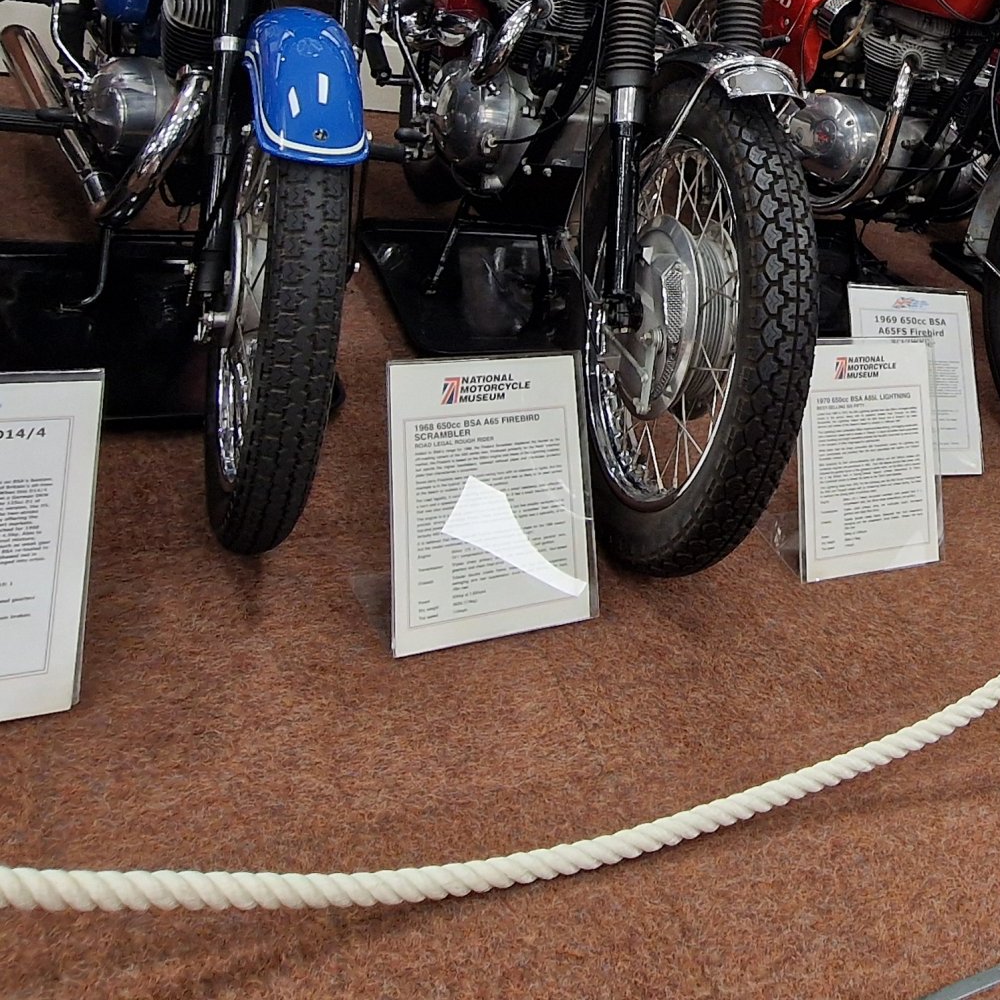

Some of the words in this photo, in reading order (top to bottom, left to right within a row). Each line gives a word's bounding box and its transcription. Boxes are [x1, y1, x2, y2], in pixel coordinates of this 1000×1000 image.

[875, 315, 897, 324] 1969
[900, 316, 926, 325] 650cc
[929, 318, 947, 326] BSA
[878, 327, 908, 336] A65FS
[910, 327, 945, 337] Firebird
[848, 355, 885, 363] NATIONAL
[847, 362, 897, 371] MOTORCYCLE
[461, 373, 515, 385] NATIONAL
[846, 371, 880, 379] MUSEUM
[460, 381, 531, 394] MOTORCYCLE
[459, 392, 506, 403] MUSEUM
[879, 392, 911, 401] LIGHTNING
[414, 424, 434, 432] 1968
[436, 421, 461, 431] 650cc
[463, 419, 482, 428] BSA
[483, 417, 499, 426] A65
[501, 413, 540, 424] FIREBIRD
[414, 429, 471, 442] SCRAMBLER
[433, 439, 453, 447] LEGAL
[454, 437, 476, 445] ROUGH
